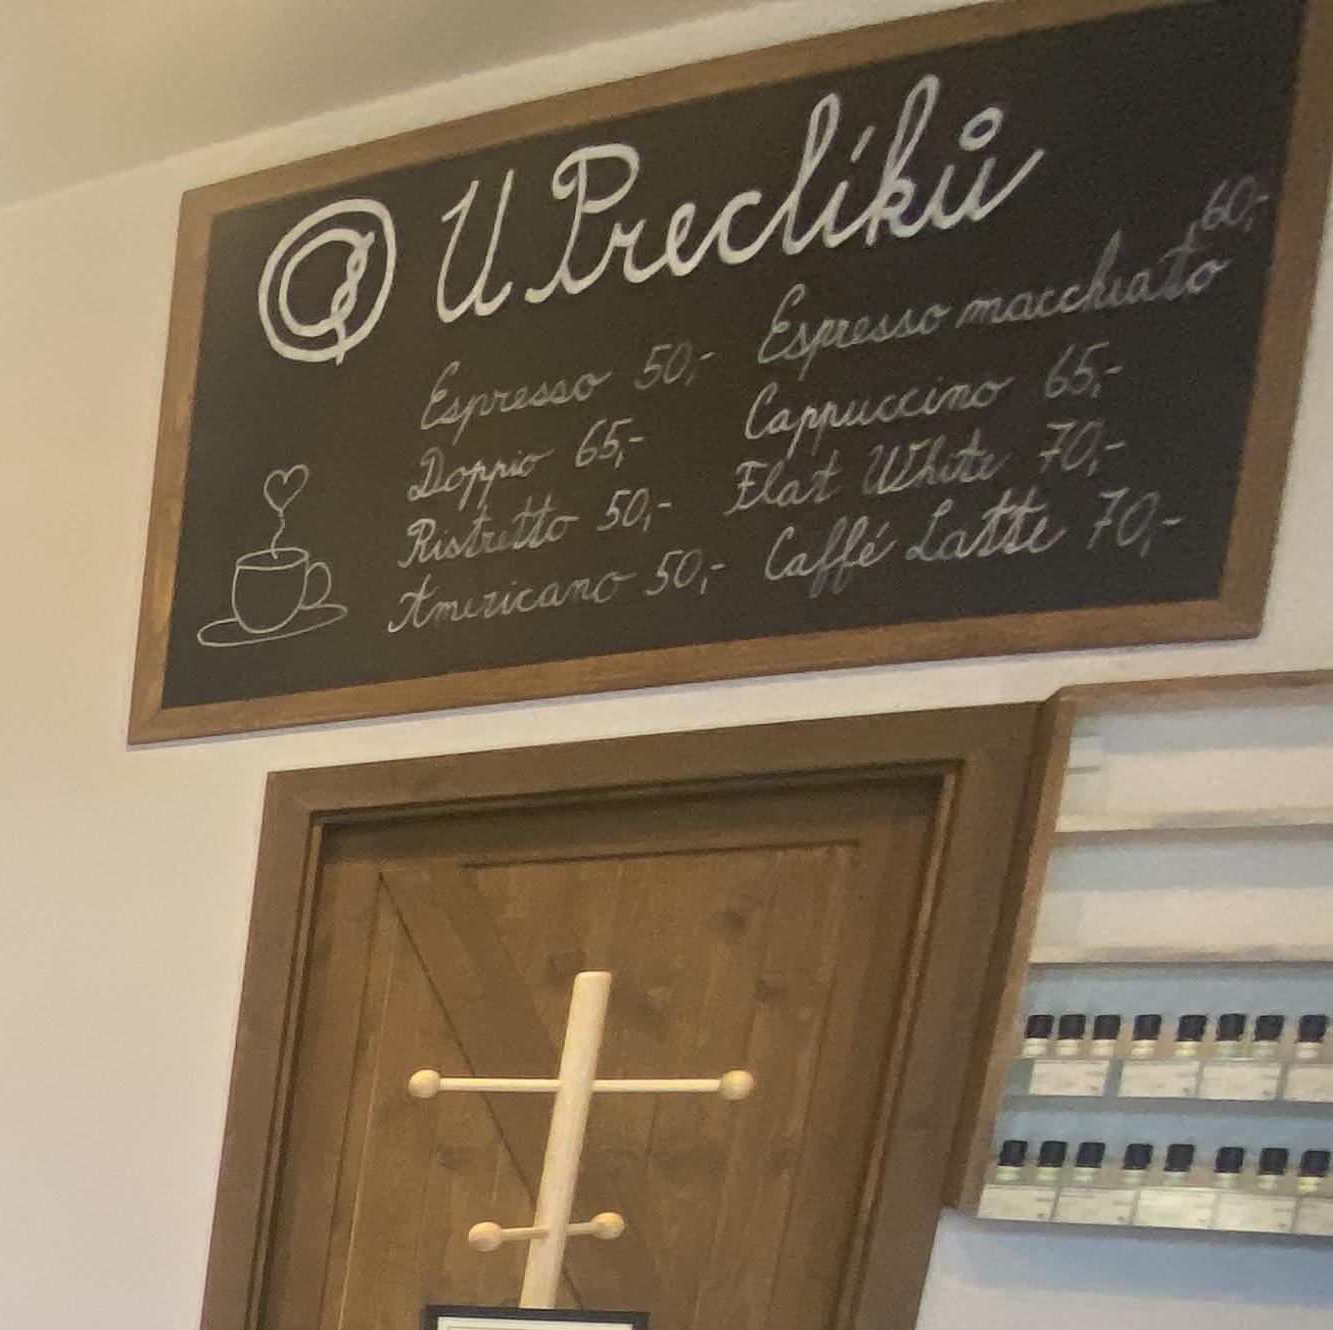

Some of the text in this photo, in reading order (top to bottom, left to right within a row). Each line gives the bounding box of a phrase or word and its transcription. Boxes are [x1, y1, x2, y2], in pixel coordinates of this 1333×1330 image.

[437, 74, 1045, 322] U Preclíků
[757, 220, 1230, 381] Espresso macchiato
[420, 342, 716, 446] Espresso 50,-
[744, 341, 1123, 460] Cappuccino 65,-
[407, 418, 645, 511] Doppio 65,-
[723, 419, 1127, 515] Flat White 70,-
[397, 487, 672, 568] Ristretto 50,-
[906, 486, 1067, 560] Latte
[1088, 487, 1183, 558] 70,-
[387, 550, 726, 633] Americano 50,-
